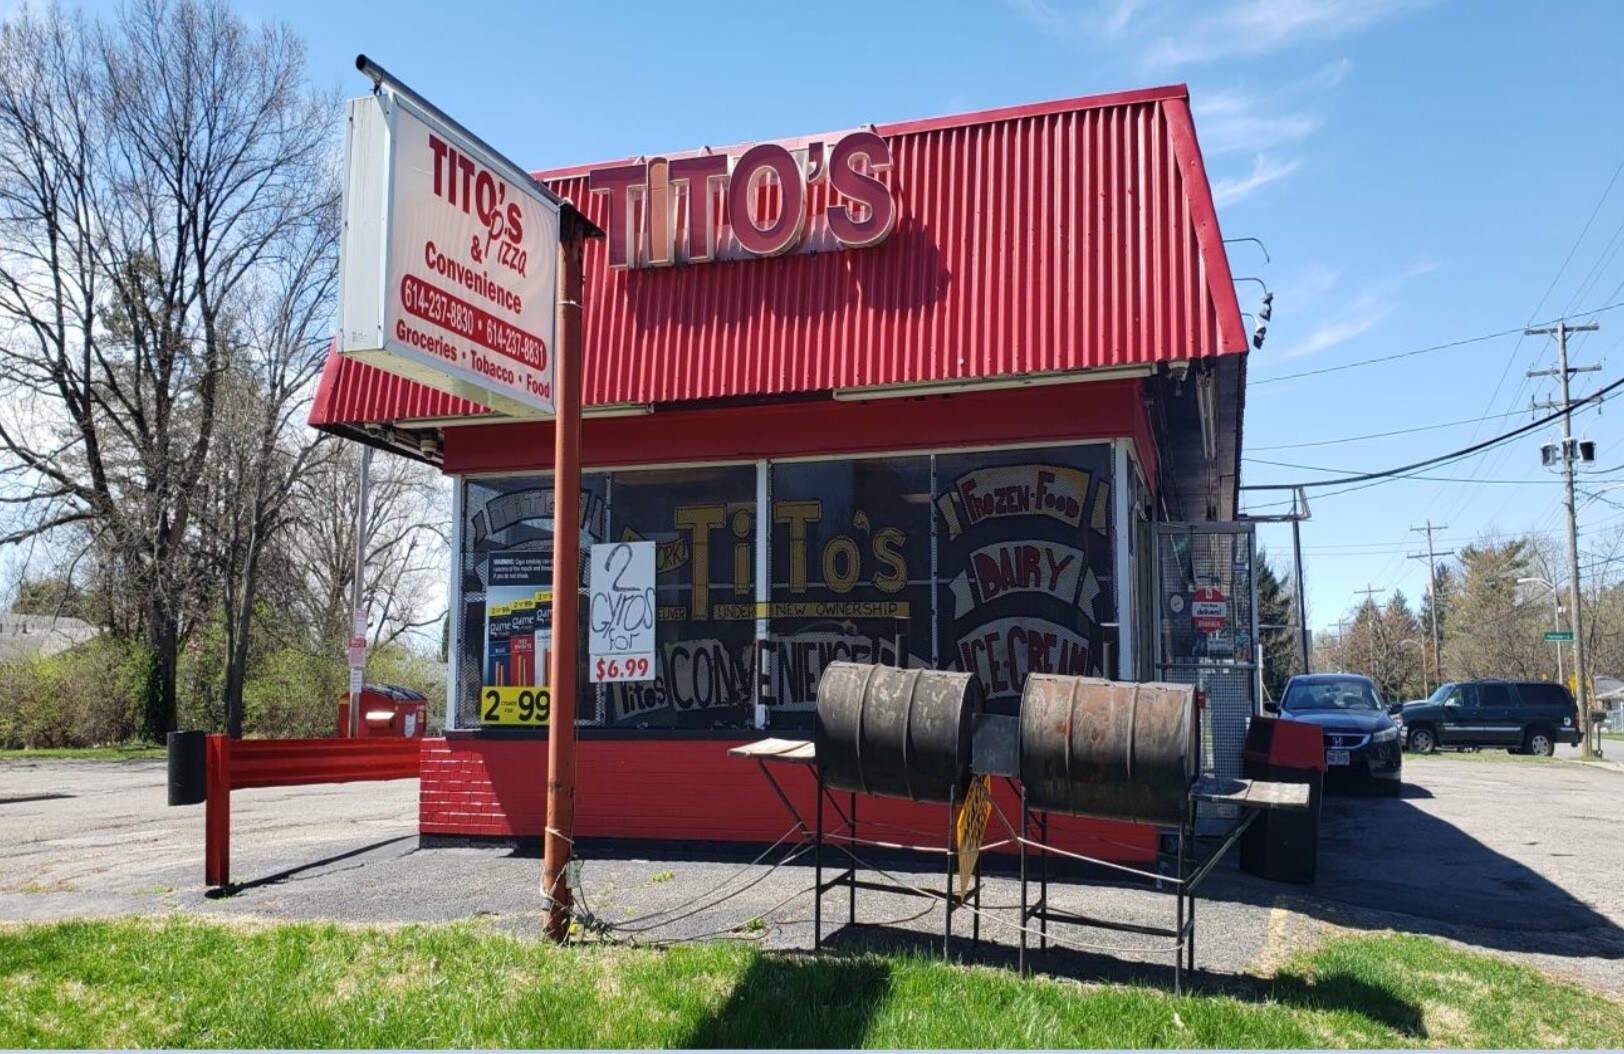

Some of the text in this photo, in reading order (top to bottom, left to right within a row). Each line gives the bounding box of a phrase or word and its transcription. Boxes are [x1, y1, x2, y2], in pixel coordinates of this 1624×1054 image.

[429, 133, 523, 245] TITO'S
[589, 131, 897, 269] TITO'S
[470, 234, 482, 264] &
[424, 240, 522, 315] Convenience
[404, 281, 544, 366] 614-237-8830 614-237-8831
[396, 318, 551, 401] Groceries Tobacco Food
[604, 544, 641, 592] 2
[656, 541, 686, 570] ORK!
[973, 545, 1076, 600] DAIRY
[656, 606, 685, 619] ELIVER
[774, 603, 806, 617] NEW
[816, 602, 898, 616] OWNERSHIP
[596, 657, 649, 681] $6.99
[485, 690, 500, 721] 2
